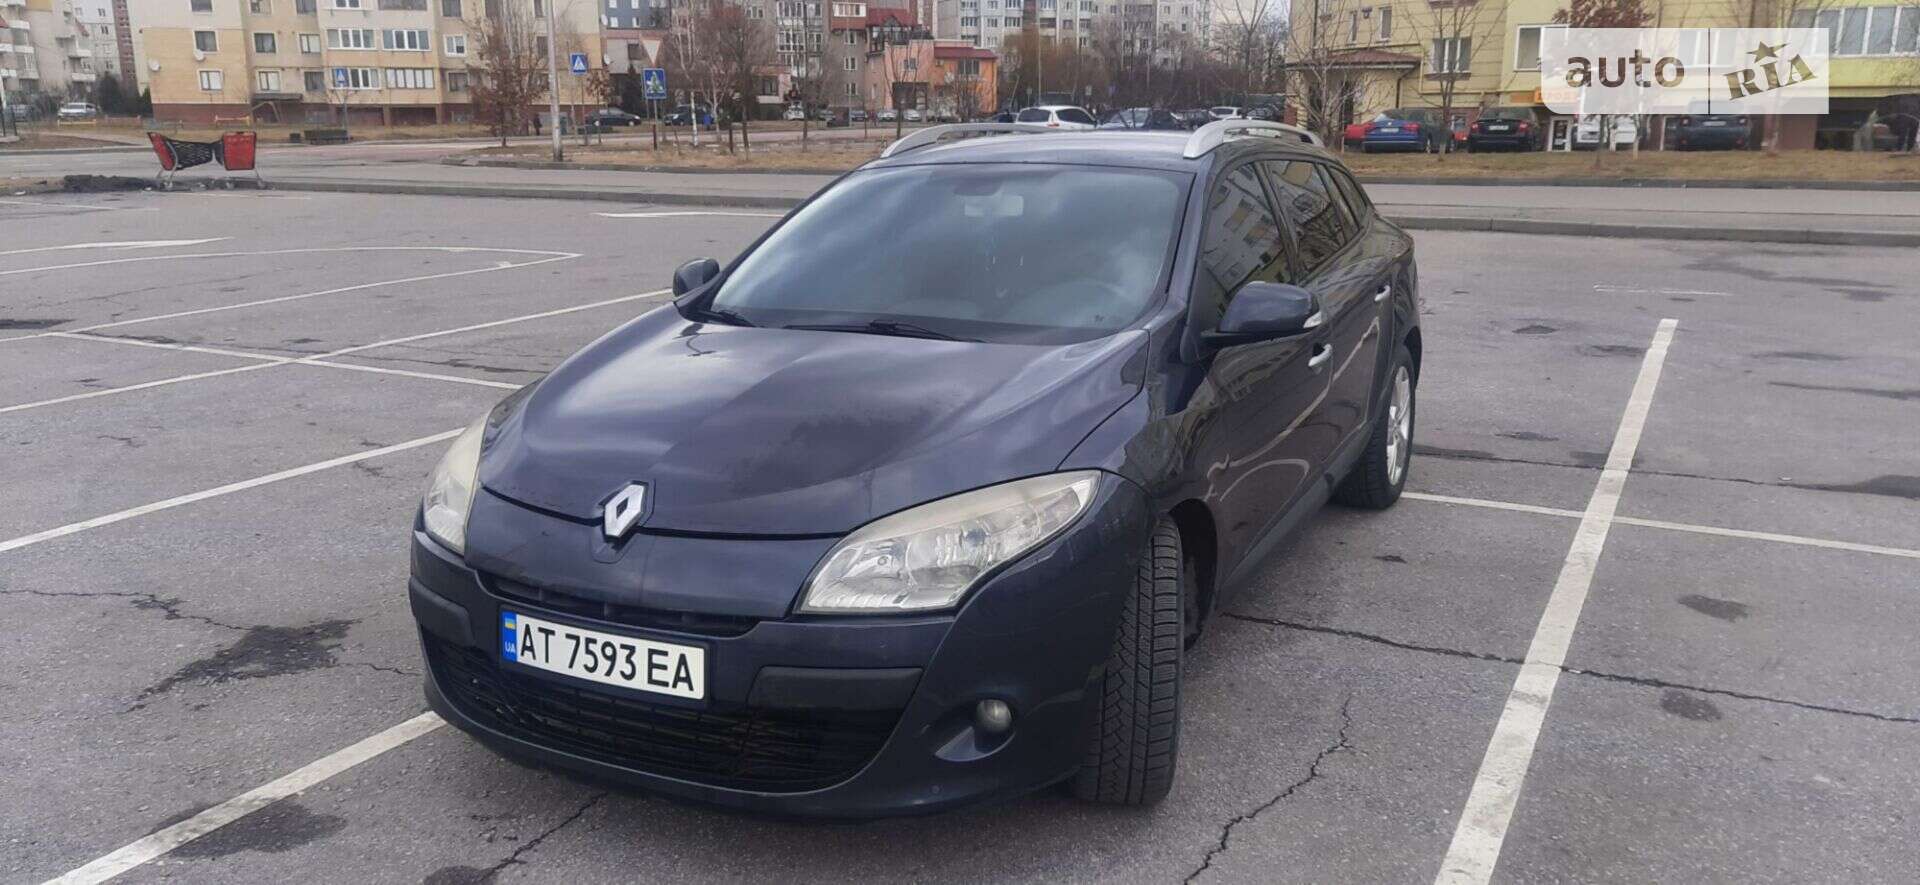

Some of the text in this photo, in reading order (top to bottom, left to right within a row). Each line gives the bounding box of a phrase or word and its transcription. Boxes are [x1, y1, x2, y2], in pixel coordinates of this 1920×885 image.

[505, 641, 516, 653] UA
[520, 623, 694, 691] AT 7593 EA
